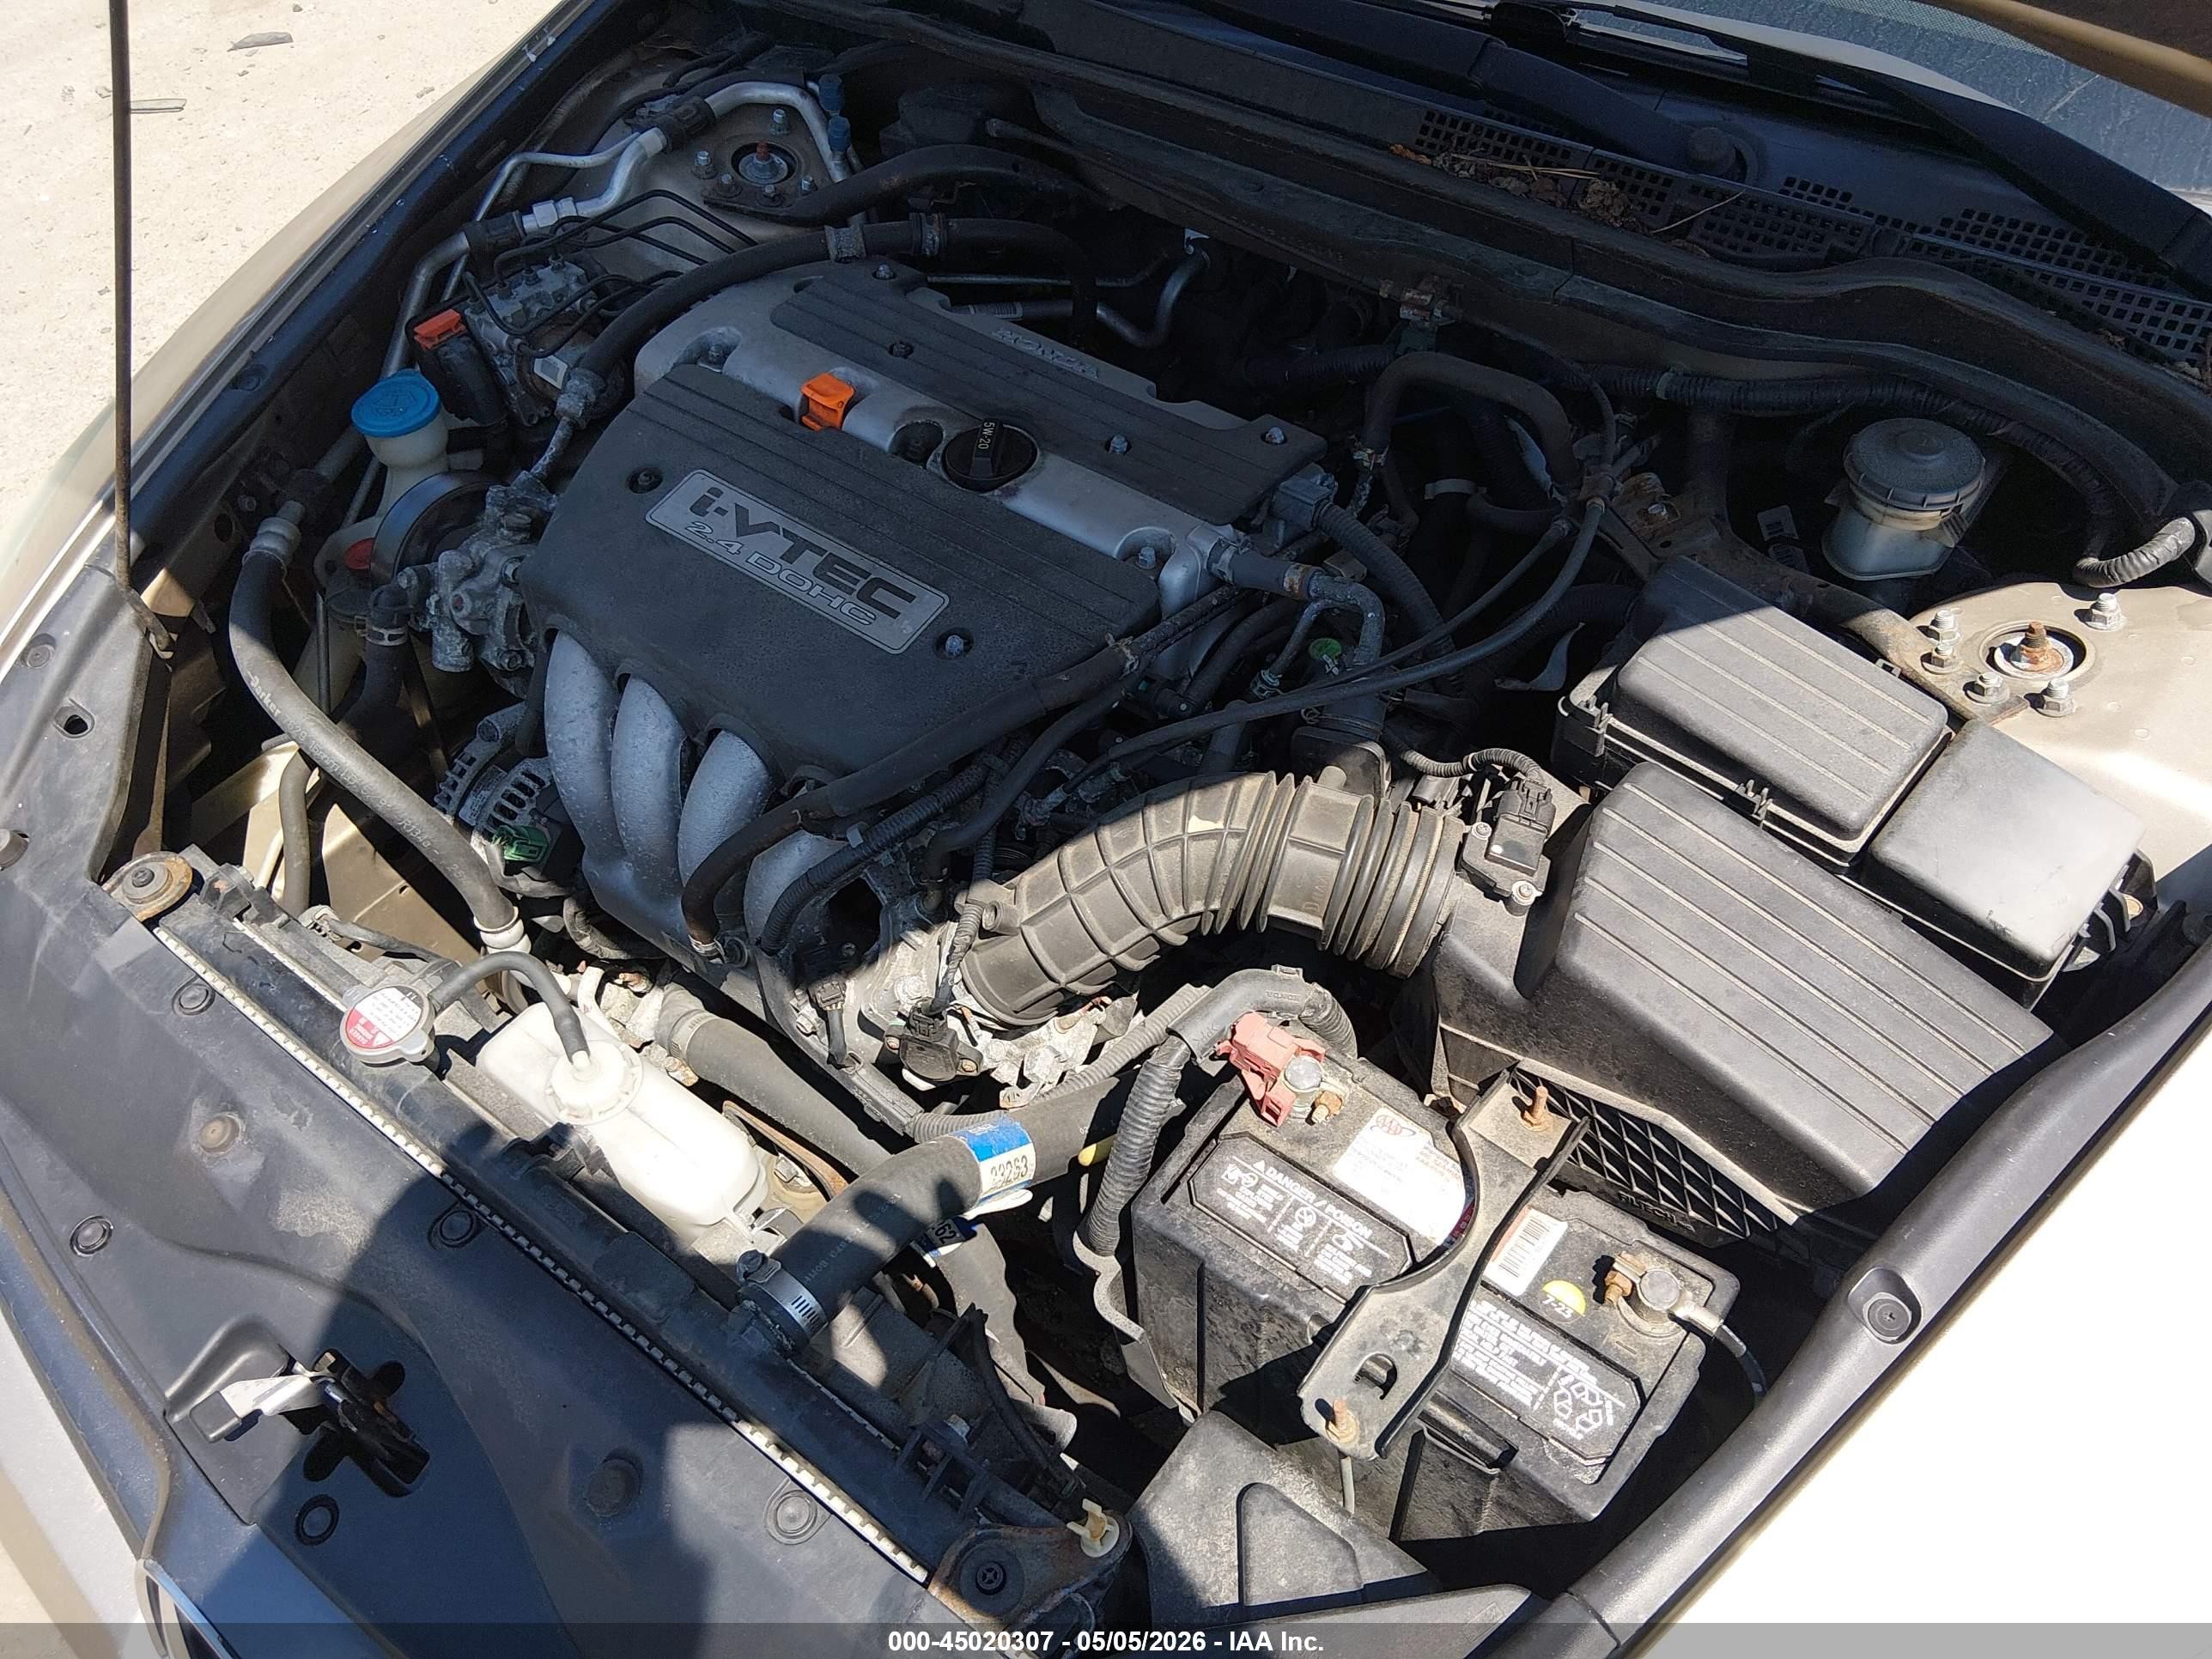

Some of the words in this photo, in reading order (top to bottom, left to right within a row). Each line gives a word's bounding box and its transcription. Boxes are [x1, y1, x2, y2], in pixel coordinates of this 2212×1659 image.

[977, 421, 996, 450] 5W-20
[685, 520, 744, 556] 2.4
[744, 550, 878, 627] DOHC
[690, 486, 916, 620] i-VTEC
[246, 672, 282, 717] Parker
[399, 818, 432, 848] R134a
[1264, 1165, 1317, 1204] DANGER
[1322, 1203, 1374, 1240] POISON
[1541, 1295, 1575, 1319] 7-23
